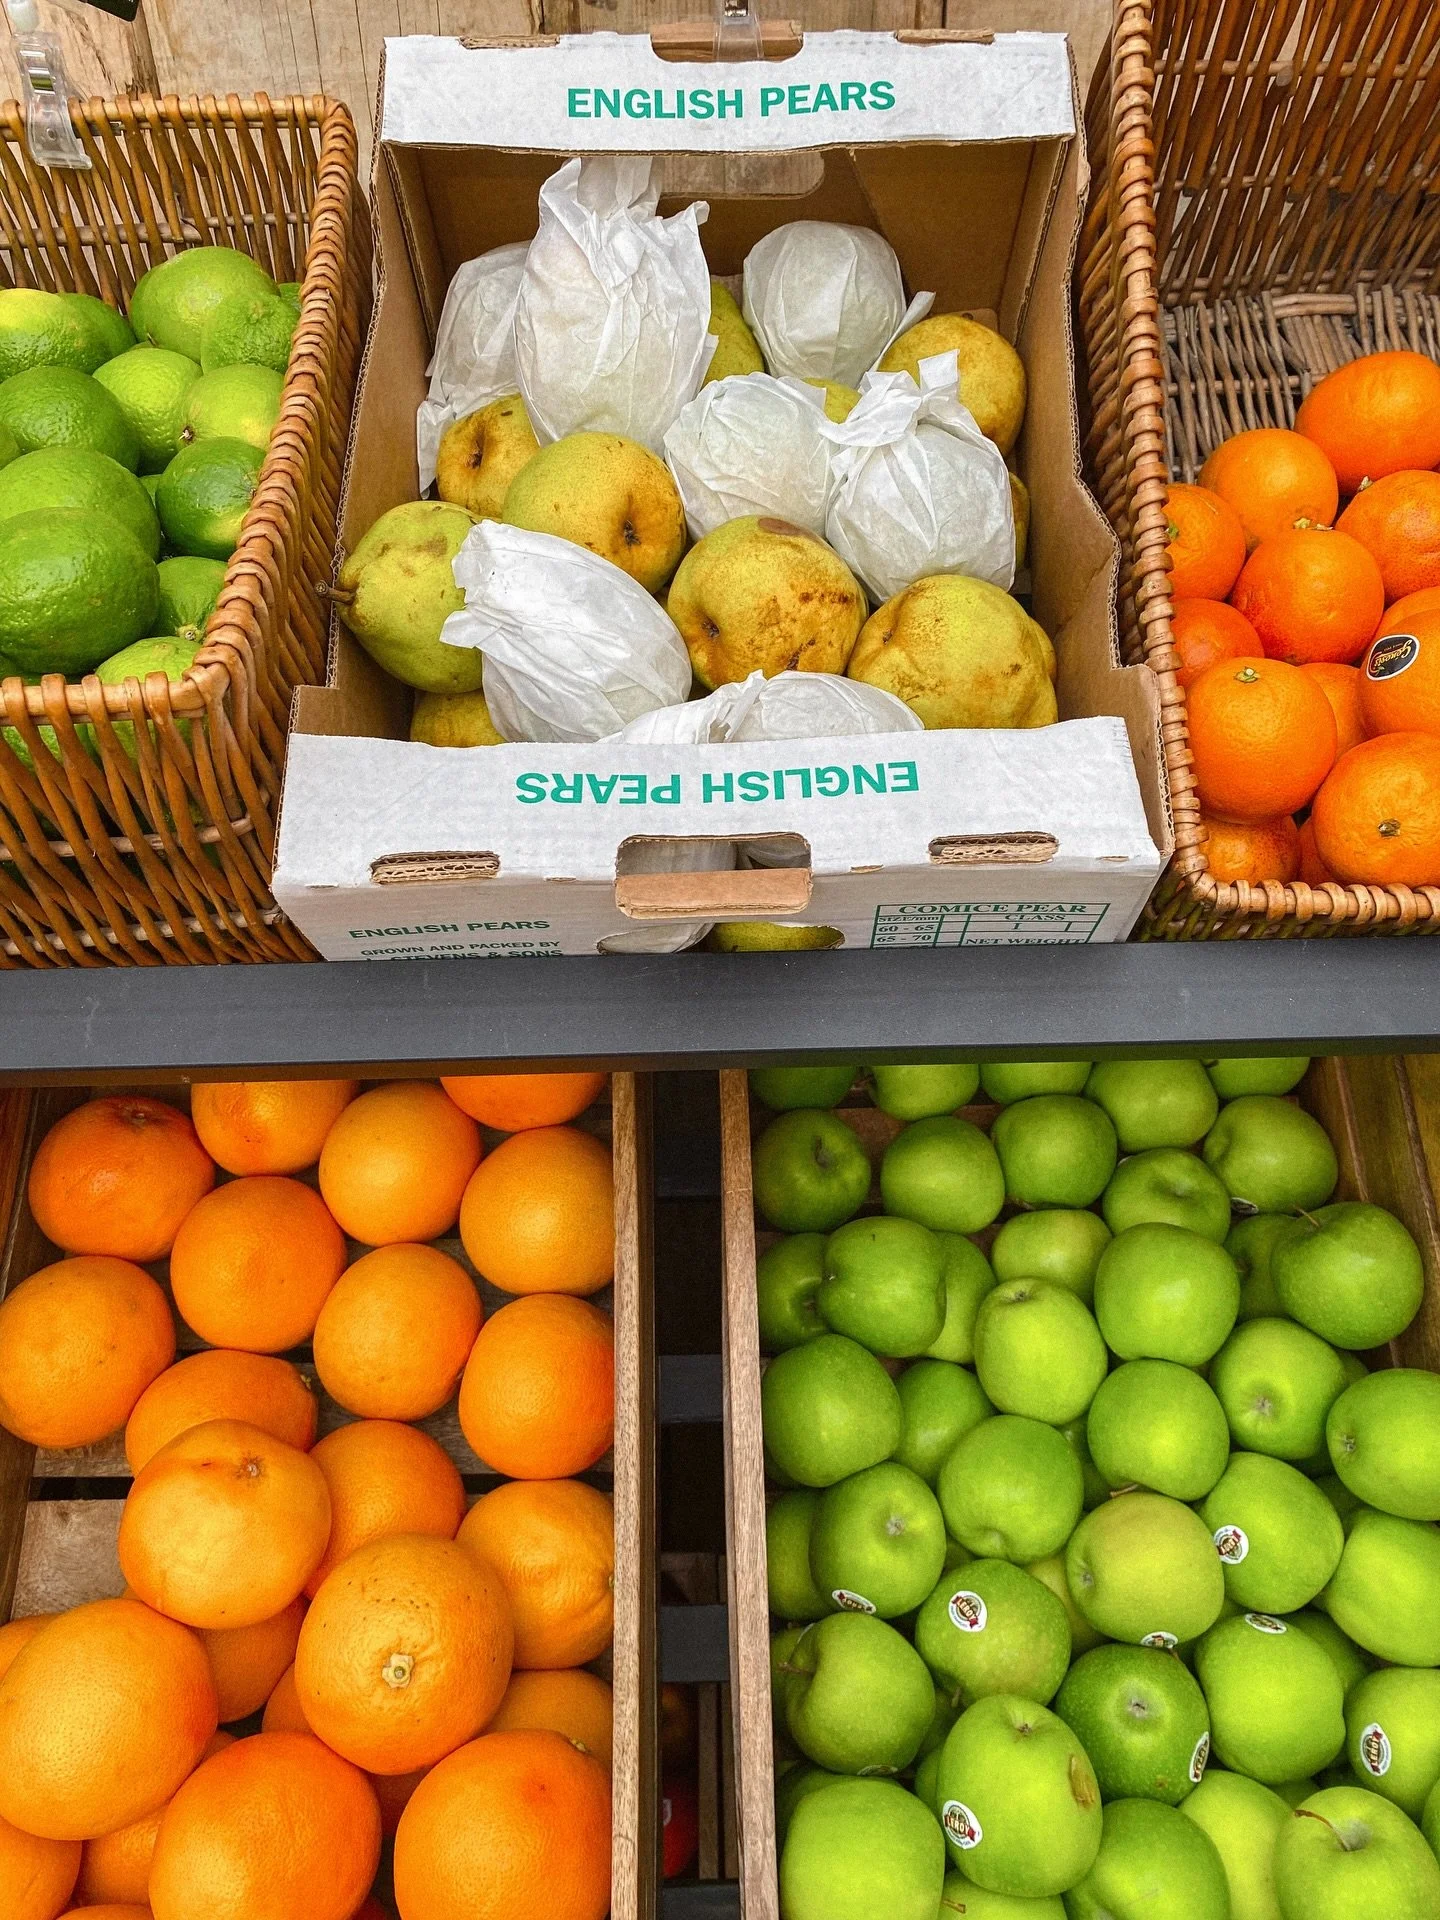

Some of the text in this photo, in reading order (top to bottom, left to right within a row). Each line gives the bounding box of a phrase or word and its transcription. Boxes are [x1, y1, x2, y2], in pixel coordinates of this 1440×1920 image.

[568, 81, 896, 119] ENGLISH PEARS
[516, 761, 920, 804] ENGLISH PEARS
[898, 904, 1087, 914] COMICE PEAR
[348, 920, 550, 938] ENGLISH PEARS
[360, 946, 425, 956] GROWN
[429, 944, 465, 952] AND
[468, 941, 535, 949] PACKED
[508, 949, 563, 958] SONS
[956, 1598, 978, 1621] LEROY
[1370, 1735, 1380, 1767] LEROY
[946, 1814, 971, 1836] LEROY
